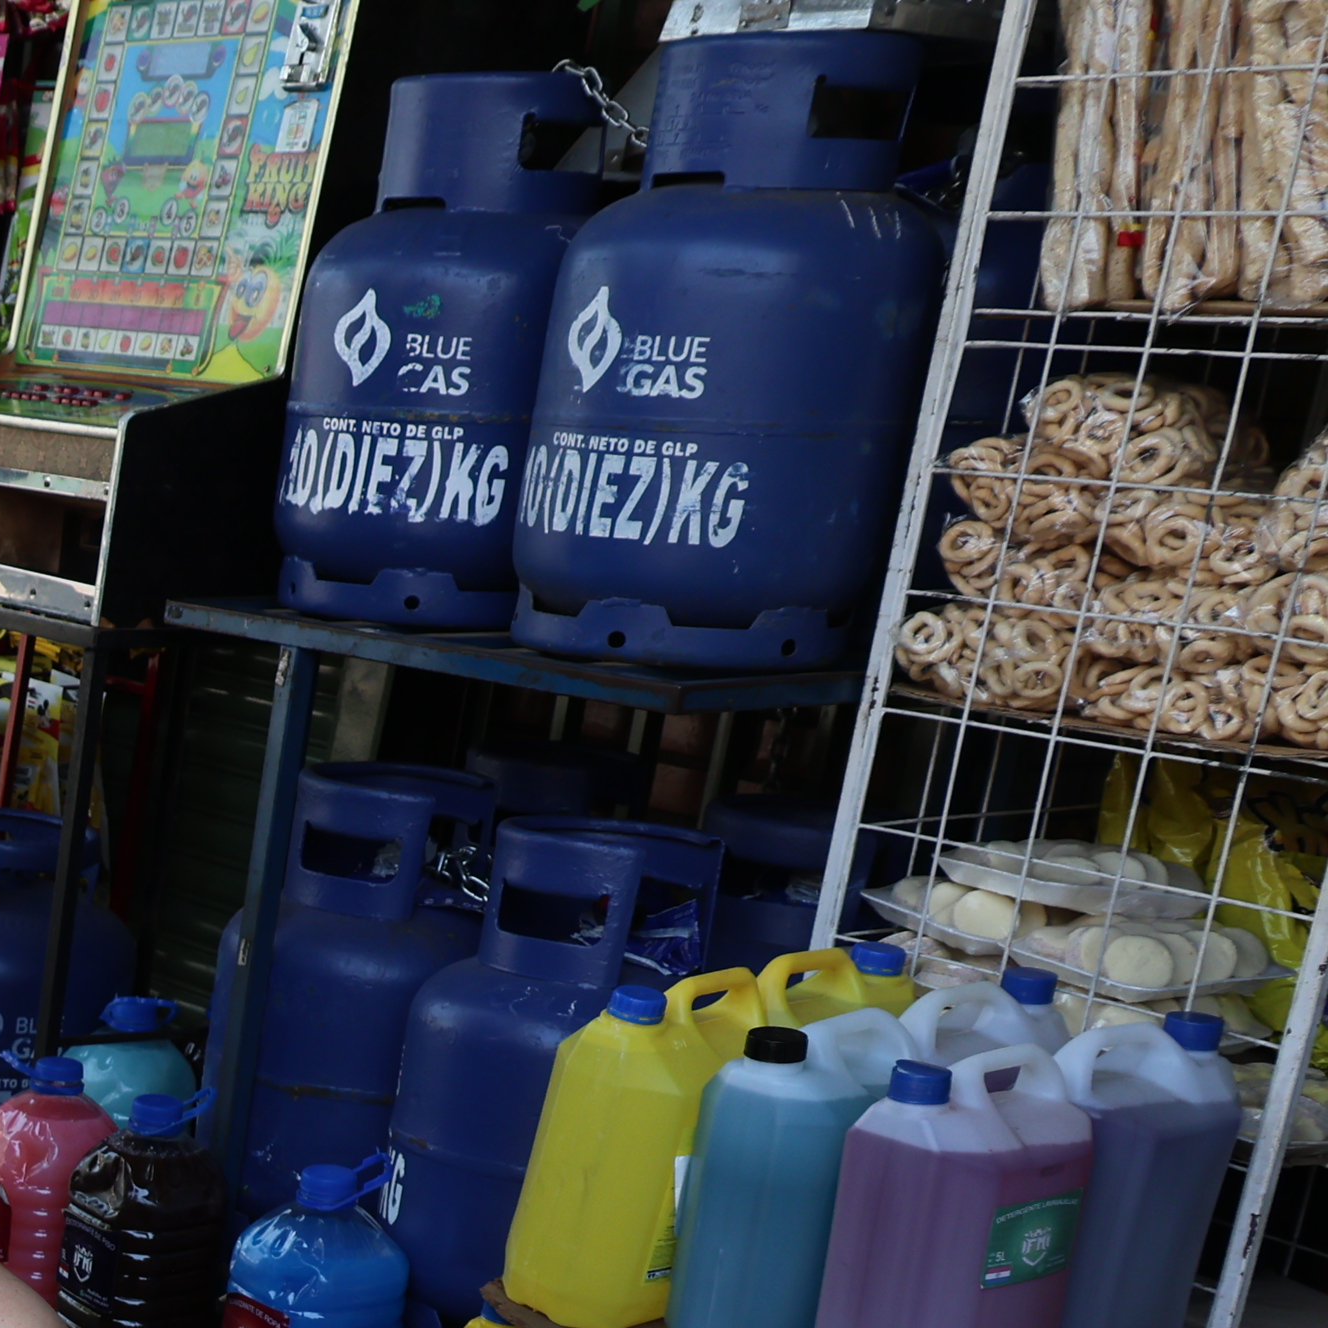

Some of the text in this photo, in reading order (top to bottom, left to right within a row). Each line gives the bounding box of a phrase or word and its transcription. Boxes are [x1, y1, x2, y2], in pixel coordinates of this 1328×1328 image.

[244, 181, 309, 226] KING
[406, 333, 472, 361] BLUE
[633, 334, 711, 363] BLUE
[626, 362, 707, 400] GAS
[323, 417, 464, 440] CONT. NETO DE GLP
[552, 431, 699, 457] CONT. NETO DE GLP
[21, 1077, 32, 1088] D
[255, 1308, 263, 1319] DE
